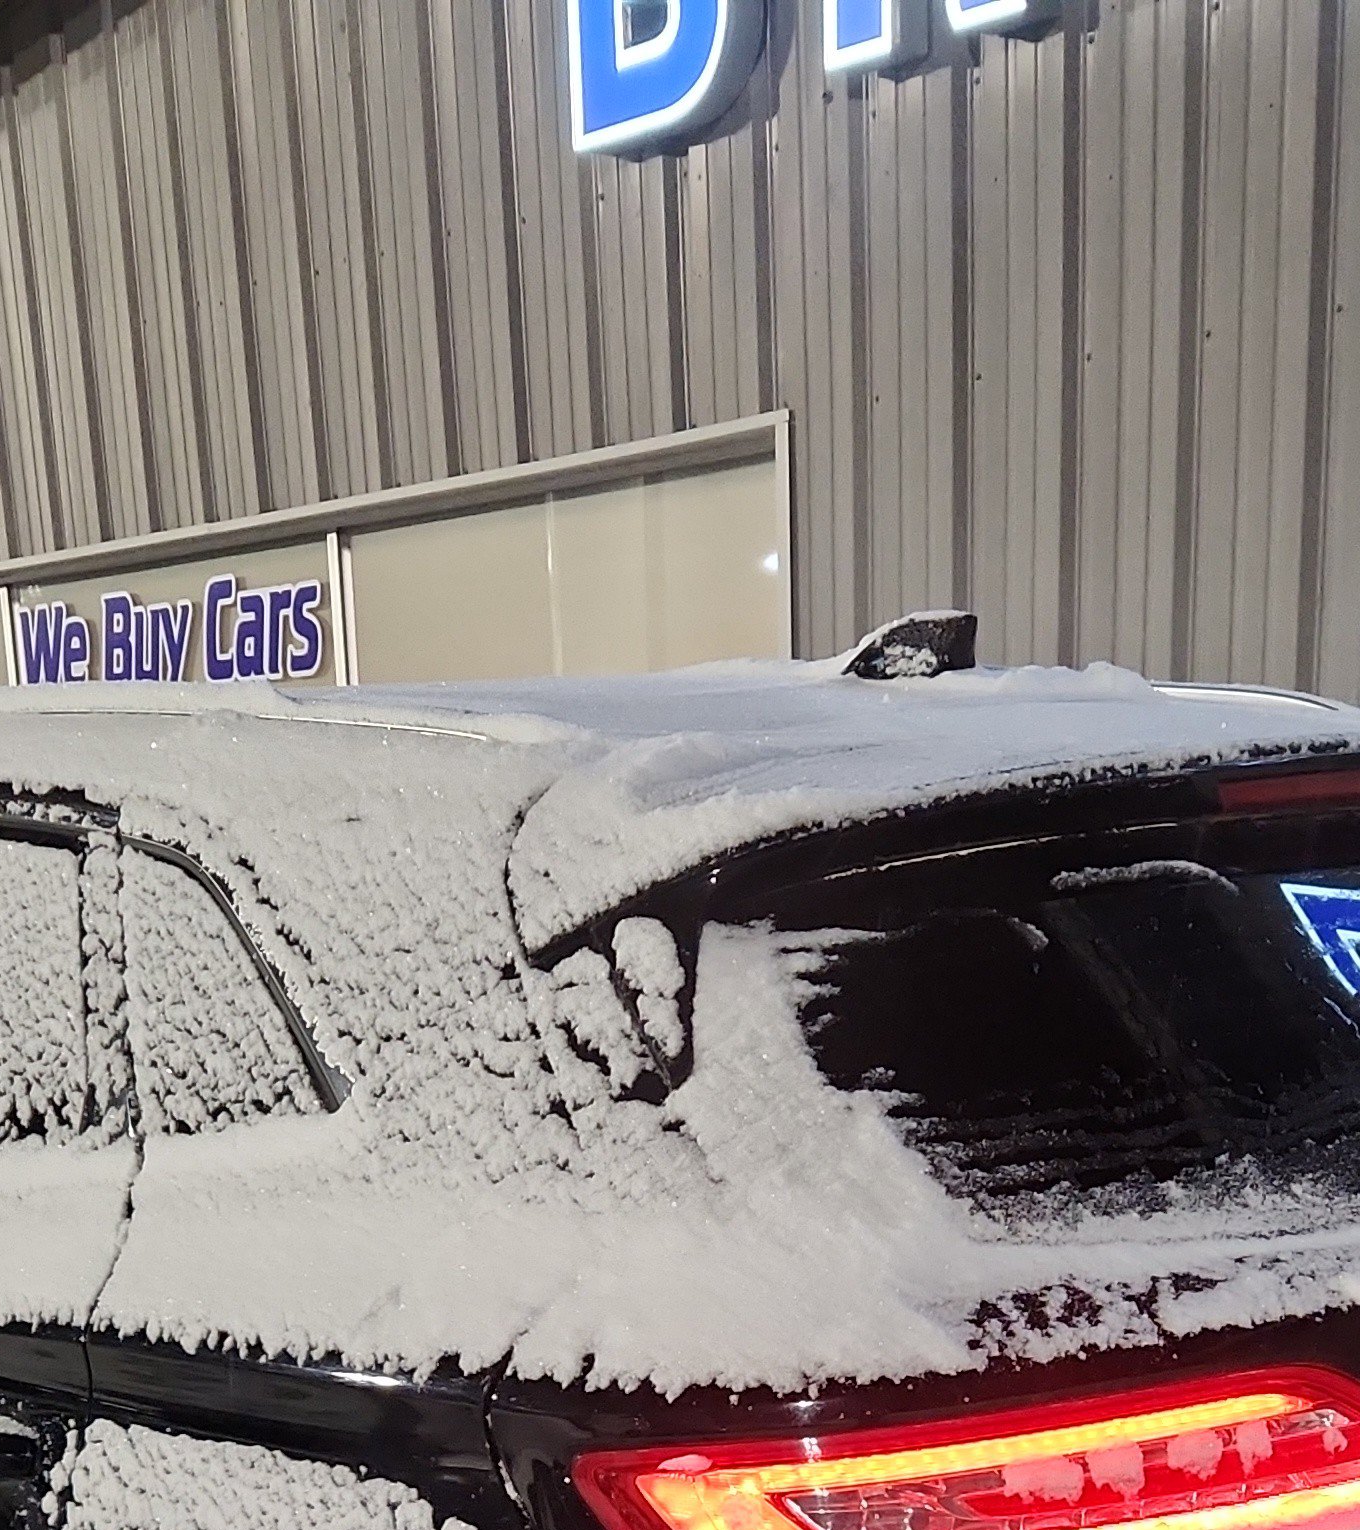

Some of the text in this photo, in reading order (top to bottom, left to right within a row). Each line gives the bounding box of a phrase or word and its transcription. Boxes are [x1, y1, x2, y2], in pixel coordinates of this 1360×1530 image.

[17, 573, 322, 685] We Buy Cars
